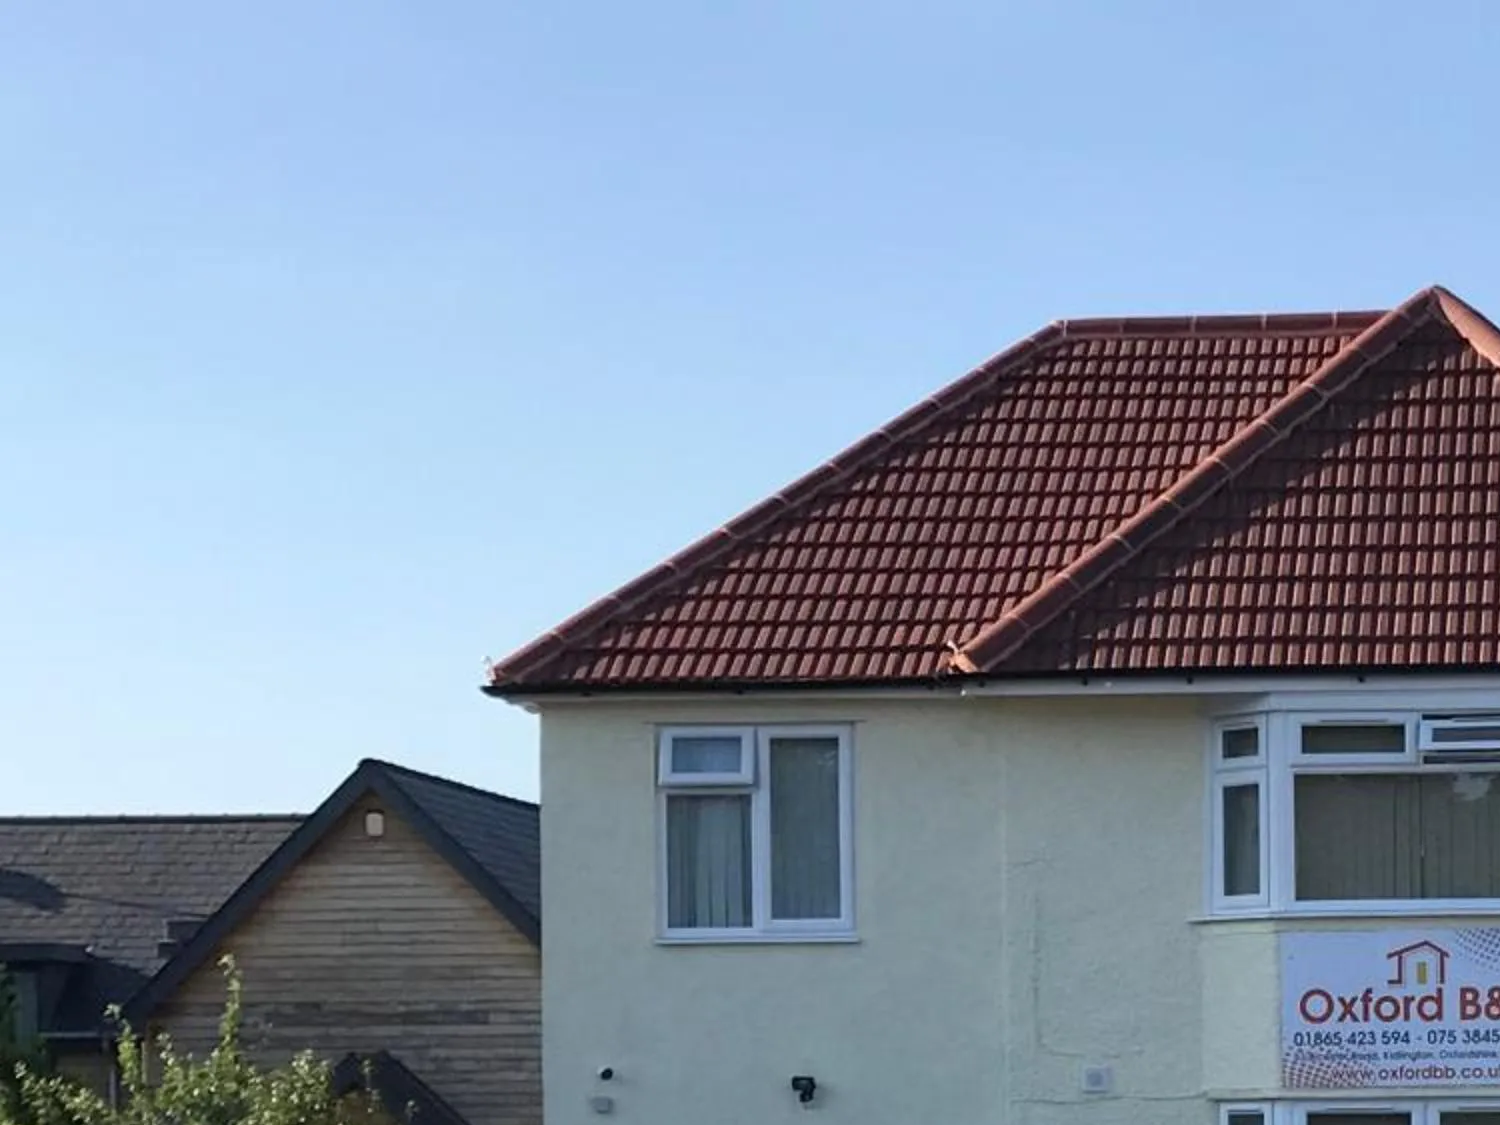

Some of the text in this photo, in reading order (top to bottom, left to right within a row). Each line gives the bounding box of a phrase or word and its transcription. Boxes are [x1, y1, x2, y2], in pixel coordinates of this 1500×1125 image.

[1300, 987, 1443, 1024] Oxford
[1293, 1031, 1342, 1047] 01865
[1347, 1030, 1377, 1045] 423
[1381, 1030, 1411, 1044] 594
[1427, 1029, 1457, 1044] 075
[1461, 1028, 1500, 1044] 3845
